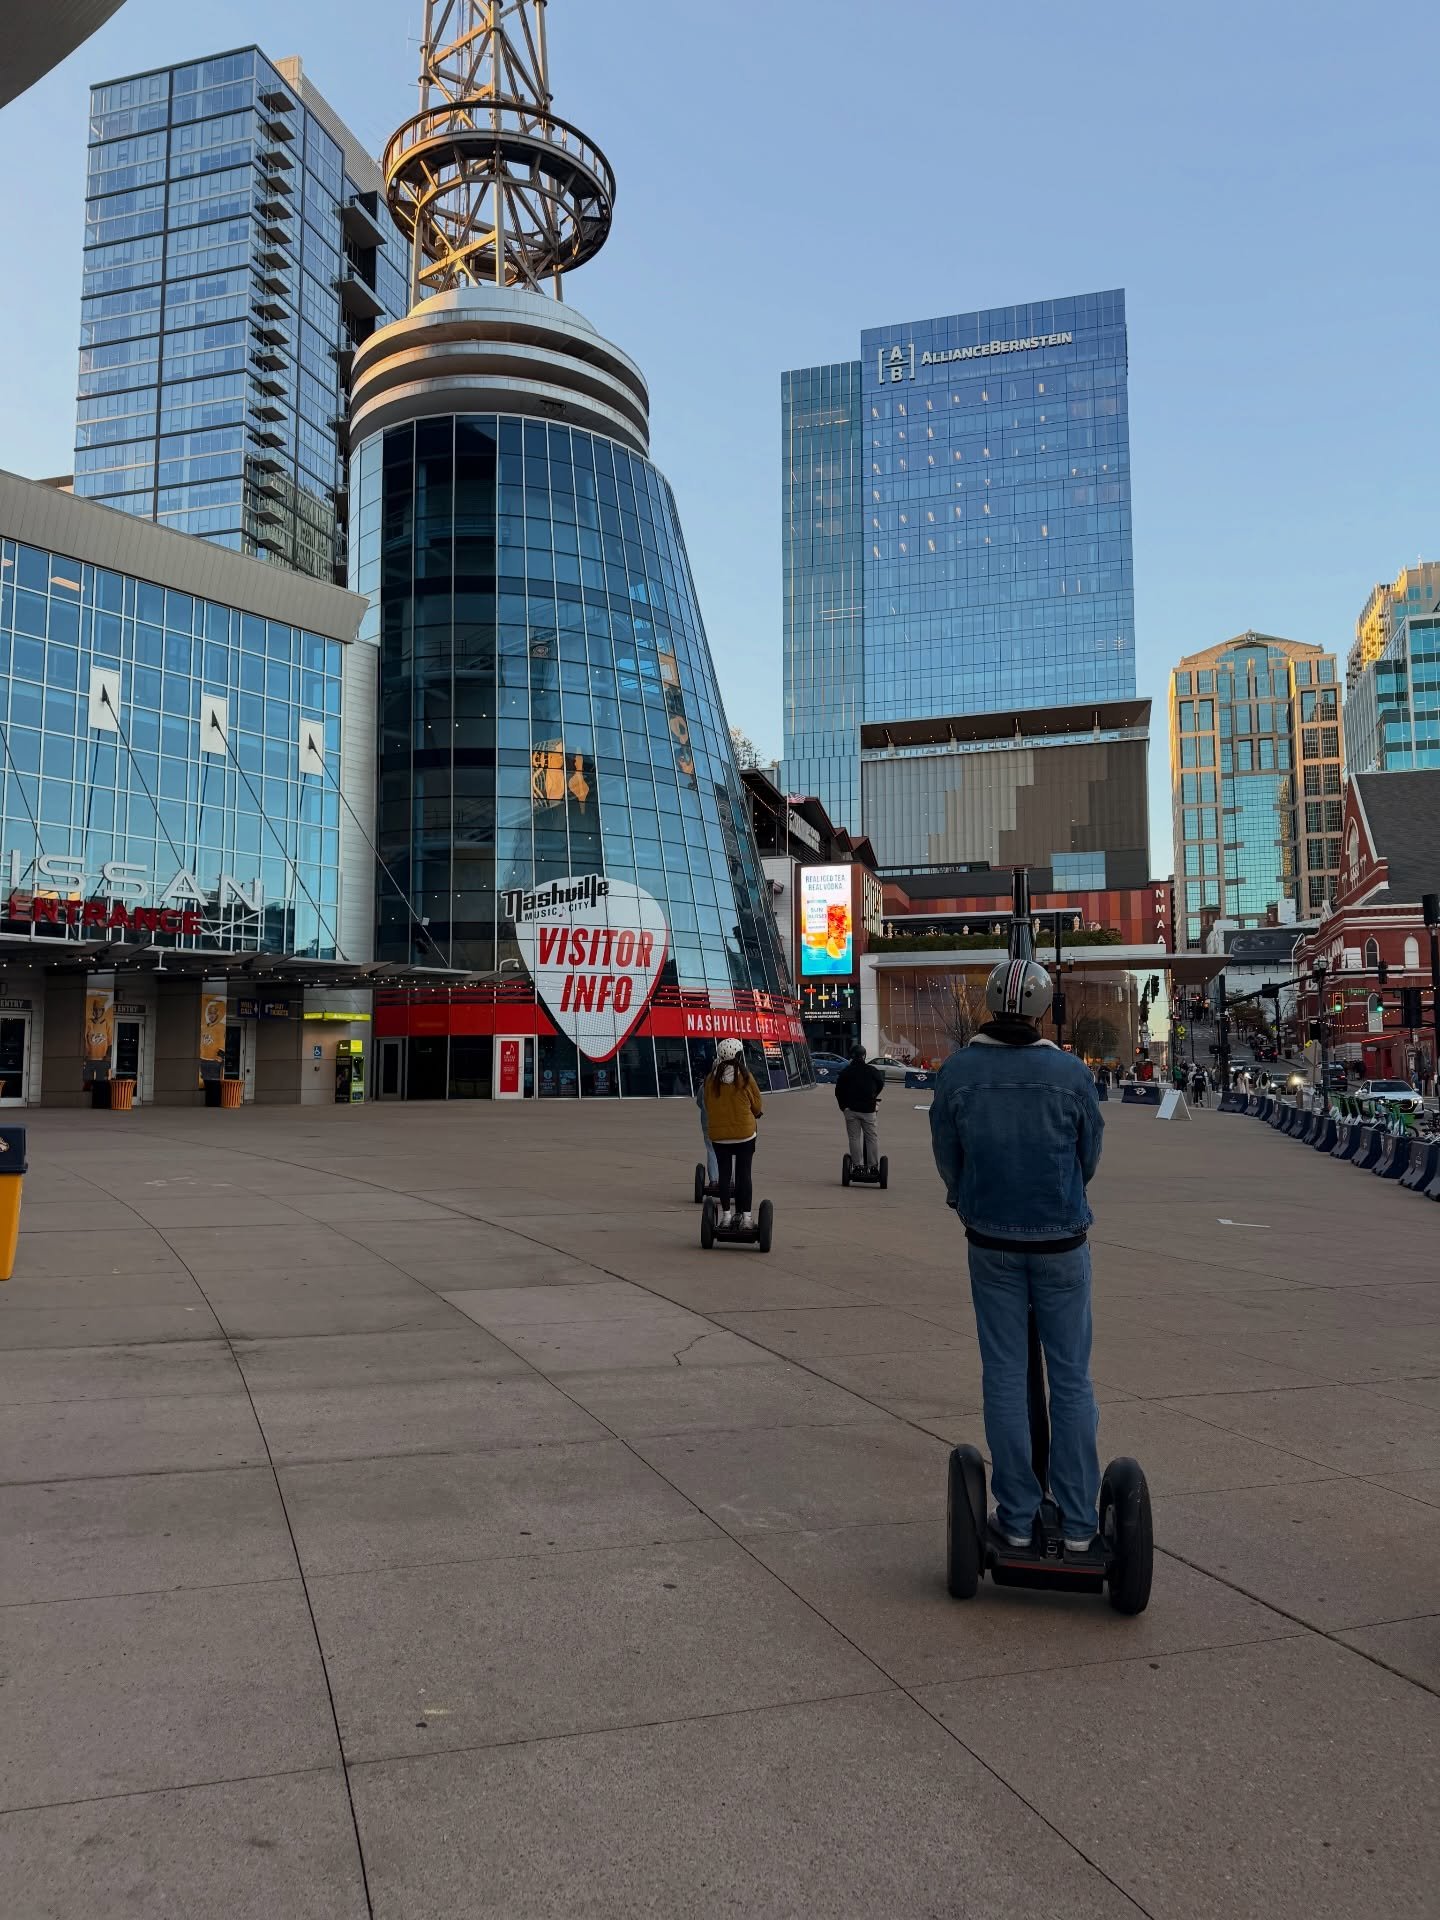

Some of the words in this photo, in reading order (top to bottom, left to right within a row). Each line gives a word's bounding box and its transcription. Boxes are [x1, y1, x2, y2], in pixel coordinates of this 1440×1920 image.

[890, 346, 903, 361] A
[921, 332, 1072, 365] ALLIANCEBERNSTEIN
[891, 367, 903, 383] B
[9, 895, 201, 935] ENTRANCE
[502, 874, 609, 923] Nashville
[524, 907, 558, 921] MUSIC
[568, 901, 590, 912] CITY
[540, 928, 653, 967] VISITOR
[560, 975, 632, 1013] INFO
[687, 1014, 752, 1033] NASHVILLE
